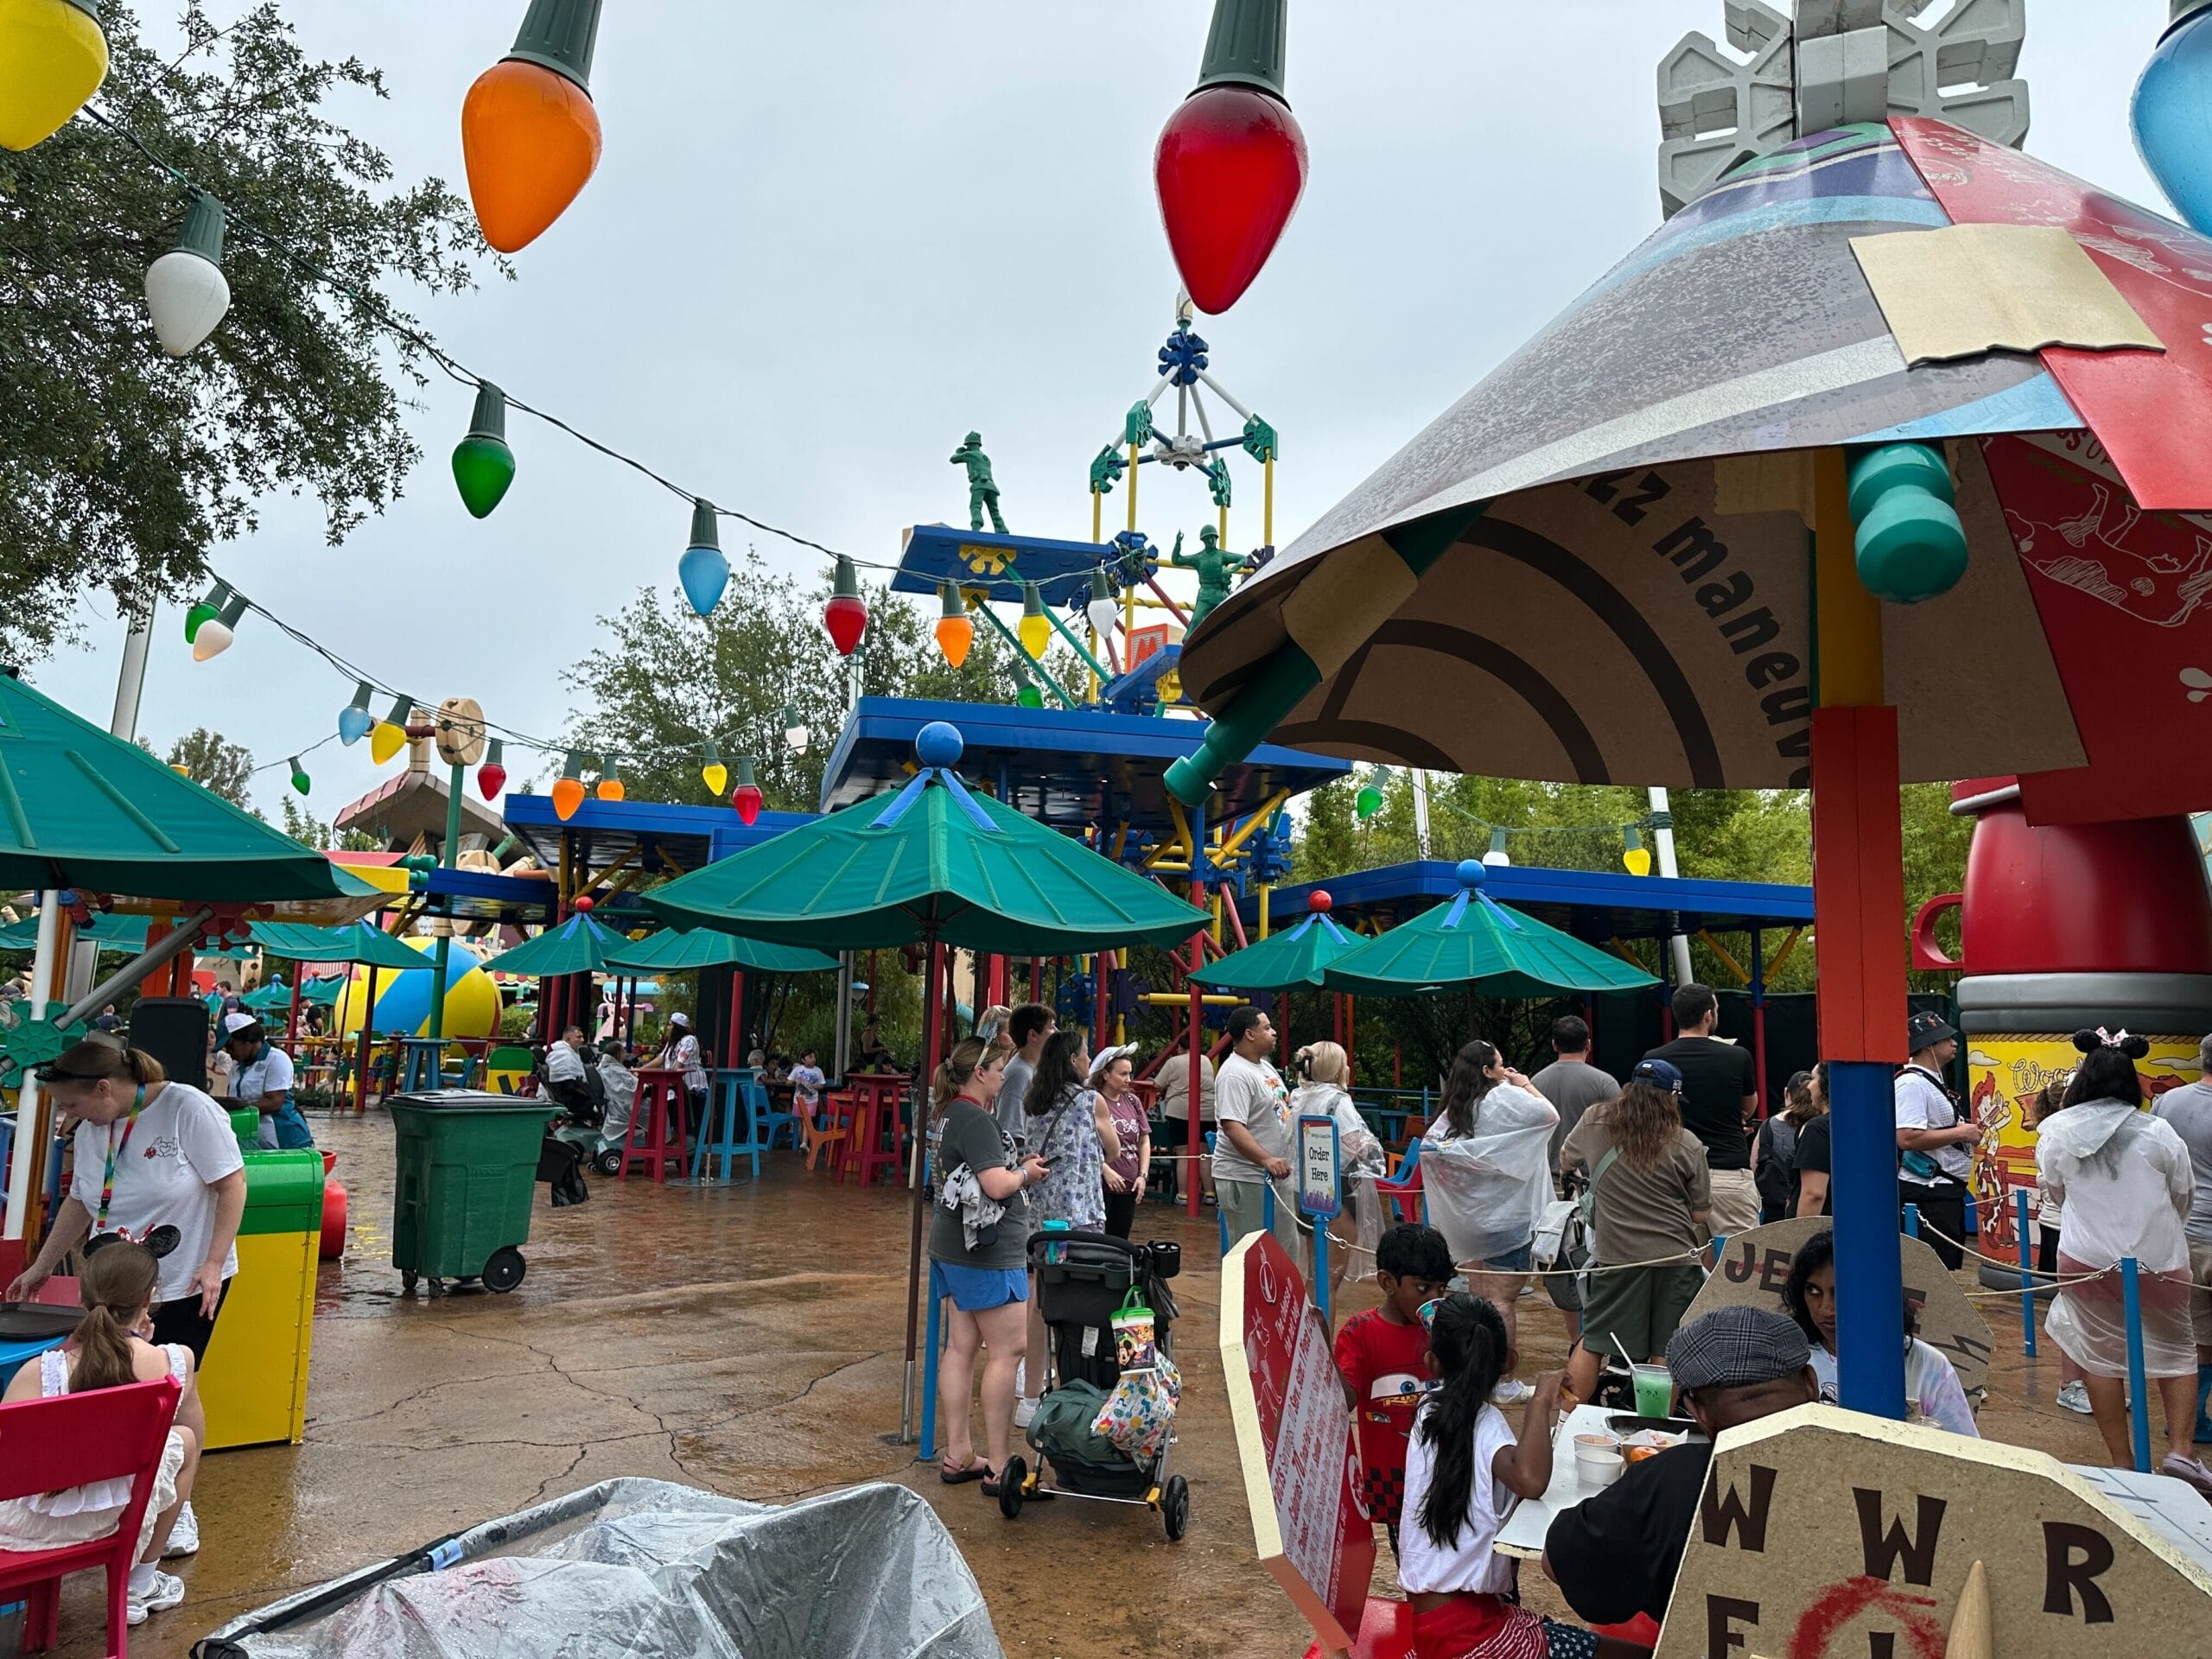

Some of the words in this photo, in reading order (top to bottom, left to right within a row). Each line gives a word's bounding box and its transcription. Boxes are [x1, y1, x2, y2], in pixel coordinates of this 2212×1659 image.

[1651, 516, 1810, 789] maneuv
[1309, 1147, 1329, 1161] Order
[1312, 1167, 1328, 1181] Here
[1700, 1459, 1777, 1553] W
[1853, 1487, 1948, 1586] W
[2043, 1521, 2114, 1624] R
